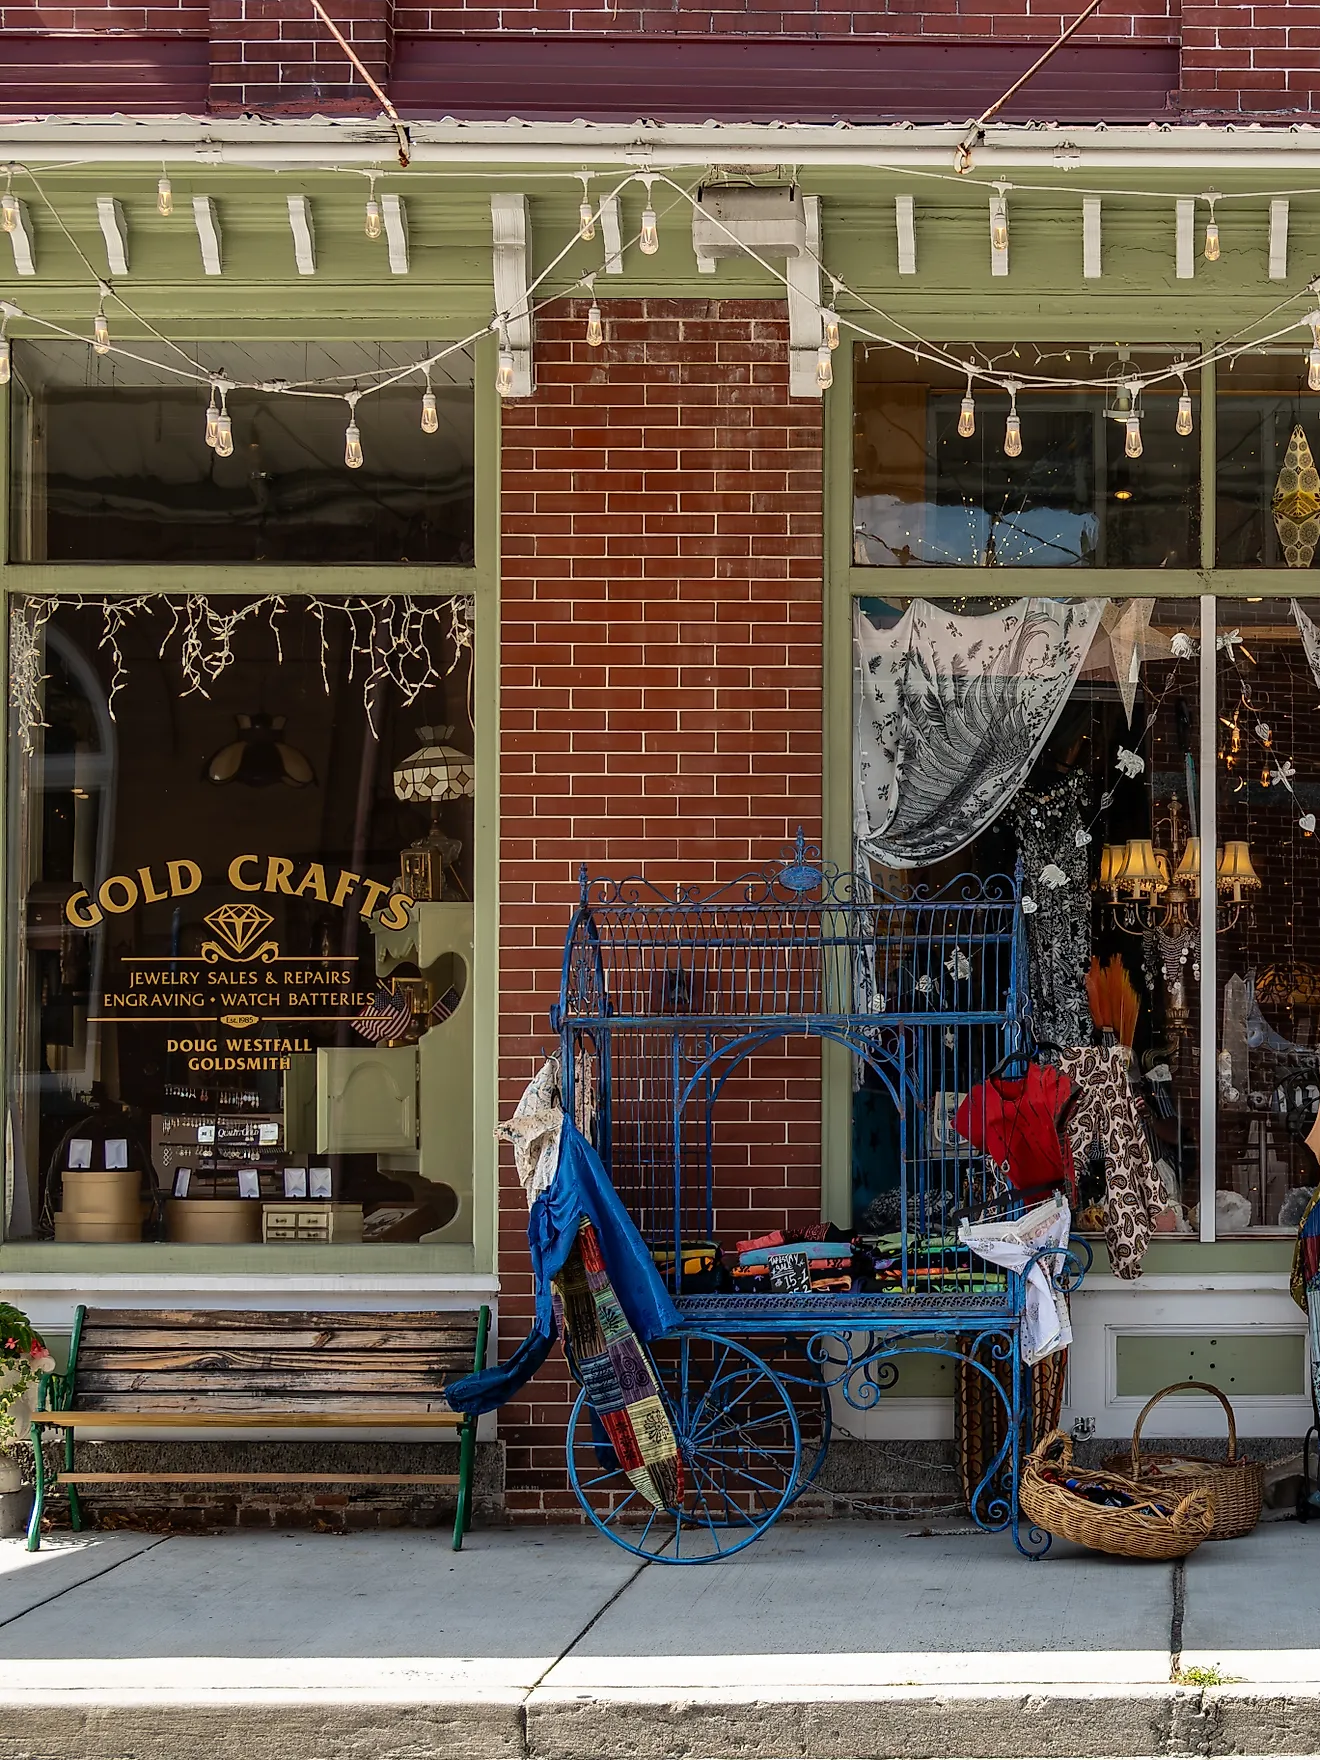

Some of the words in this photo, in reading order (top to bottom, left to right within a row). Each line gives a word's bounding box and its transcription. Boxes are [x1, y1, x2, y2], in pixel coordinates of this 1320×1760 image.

[64, 858, 203, 930] GOLD
[227, 854, 416, 932] CRAFTS
[129, 971, 200, 987] JEWELRY
[207, 971, 259, 985] SALES
[265, 971, 279, 985] &
[283, 971, 352, 985] REPAIRS
[104, 993, 205, 1007] ENGRAVING
[220, 993, 281, 1006] WATCH
[288, 993, 376, 1007] BATTERIES
[167, 1038, 218, 1052] DOUG
[226, 1038, 313, 1052] WESTFALL
[187, 1056, 292, 1071] GOLDSMITH
